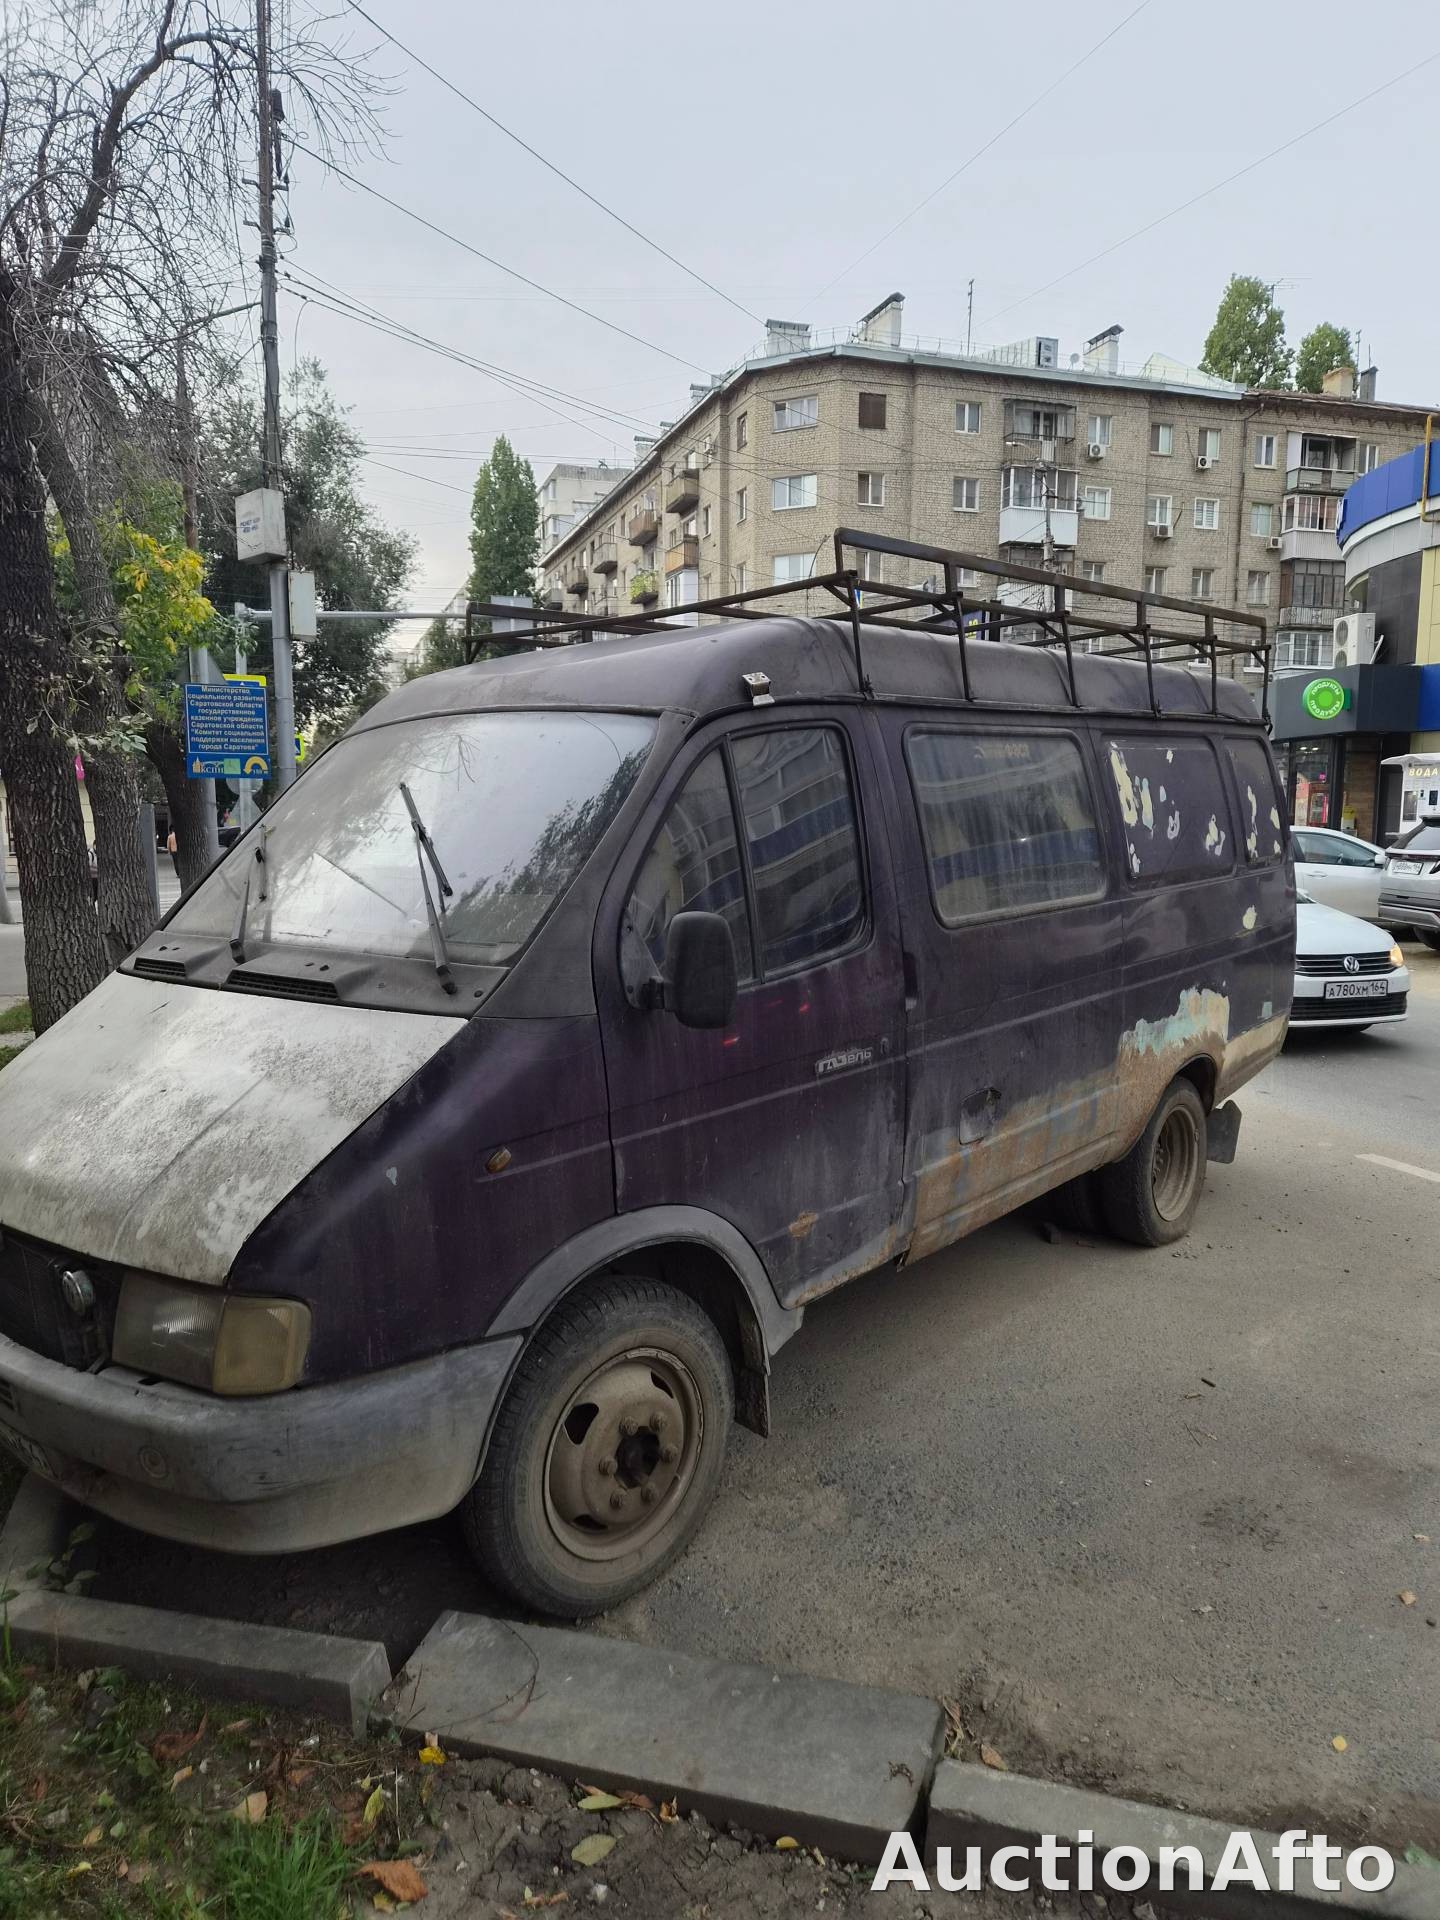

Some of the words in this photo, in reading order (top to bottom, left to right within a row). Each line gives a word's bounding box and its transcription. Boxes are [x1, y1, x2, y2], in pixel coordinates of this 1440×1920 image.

[201, 686, 250, 694] Министерство
[1311, 681, 1341, 695] ПРОДУКТЫ
[1310, 700, 1341, 716] ПРОДУКТЫ
[1408, 766, 1439, 777] ВОДА
[1328, 983, 1369, 998] А780ХМ
[1369, 981, 1386, 992] 164
